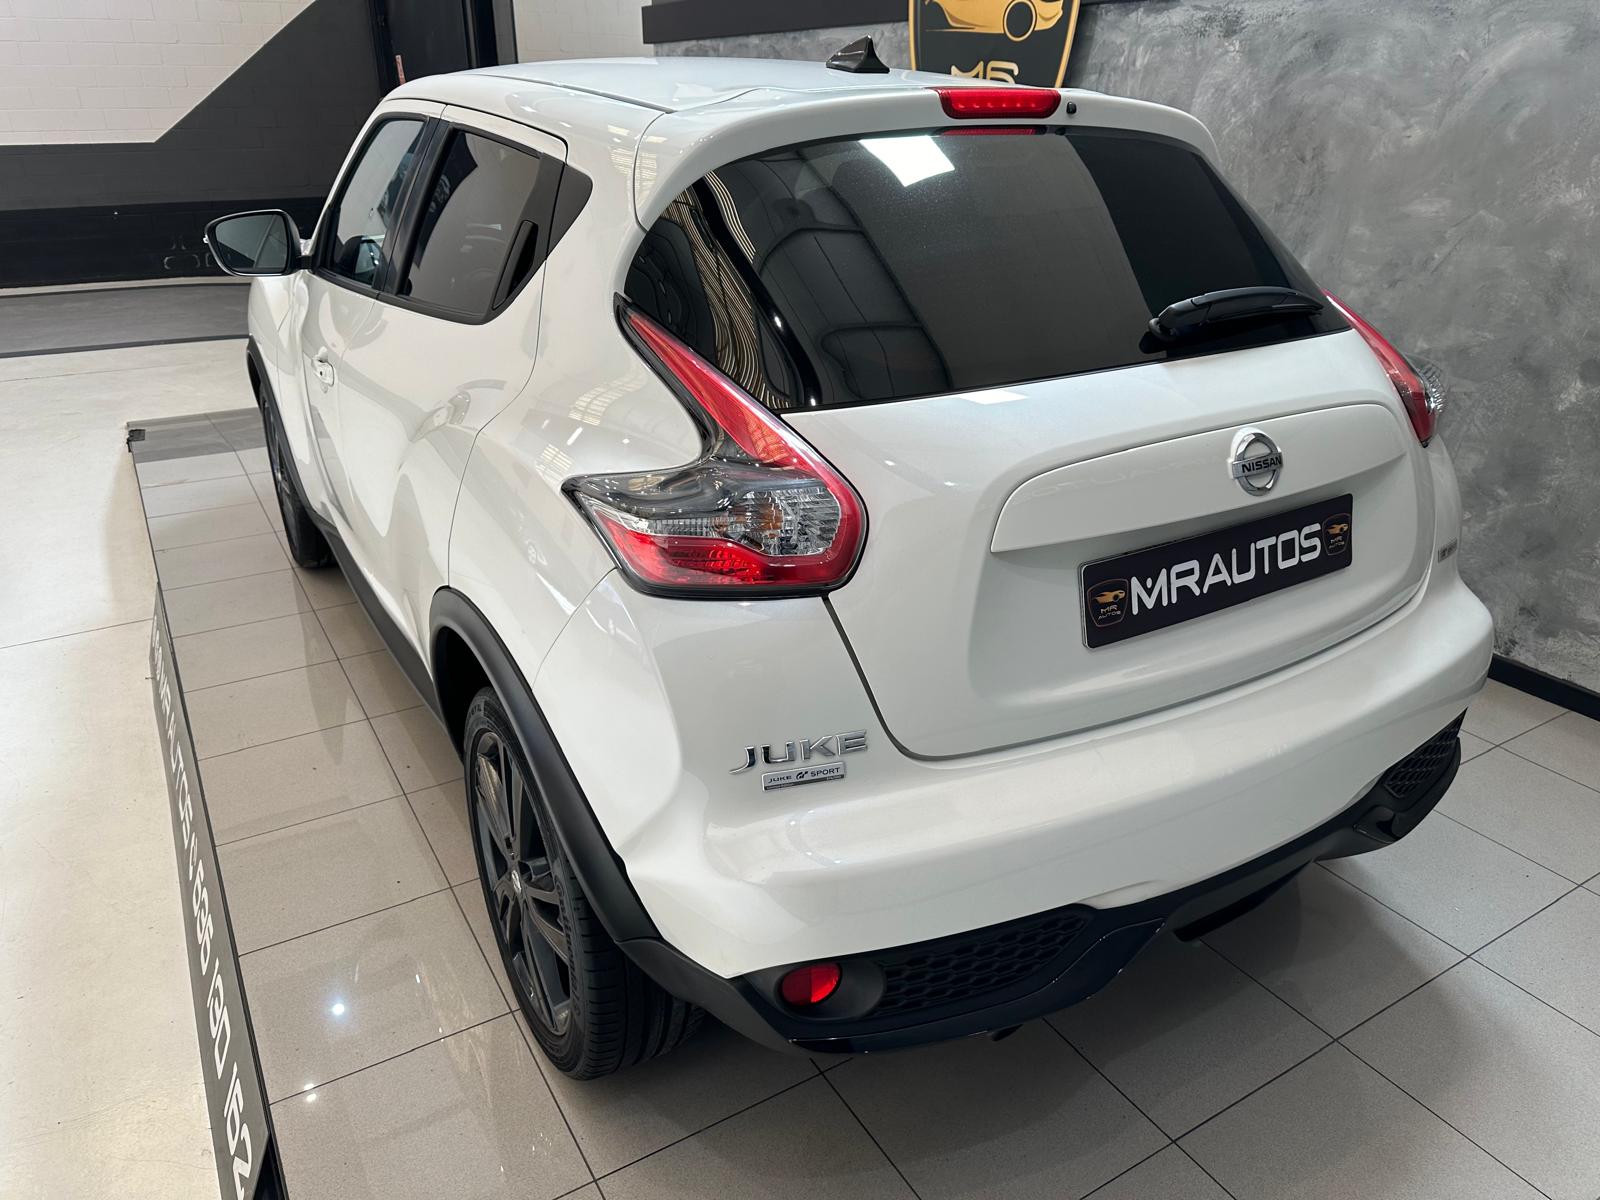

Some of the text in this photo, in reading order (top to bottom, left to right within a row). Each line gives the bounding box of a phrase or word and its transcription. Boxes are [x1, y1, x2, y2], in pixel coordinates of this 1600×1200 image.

[1241, 455, 1282, 473] NISSAN
[1130, 523, 1322, 616] MRAUTOS
[729, 729, 868, 775] JUKE
[767, 775, 793, 784] JUKE
[810, 766, 841, 778] SPORT
[192, 859, 214, 976] 636
[207, 957, 231, 1080] 130
[223, 1061, 252, 1200] 162
